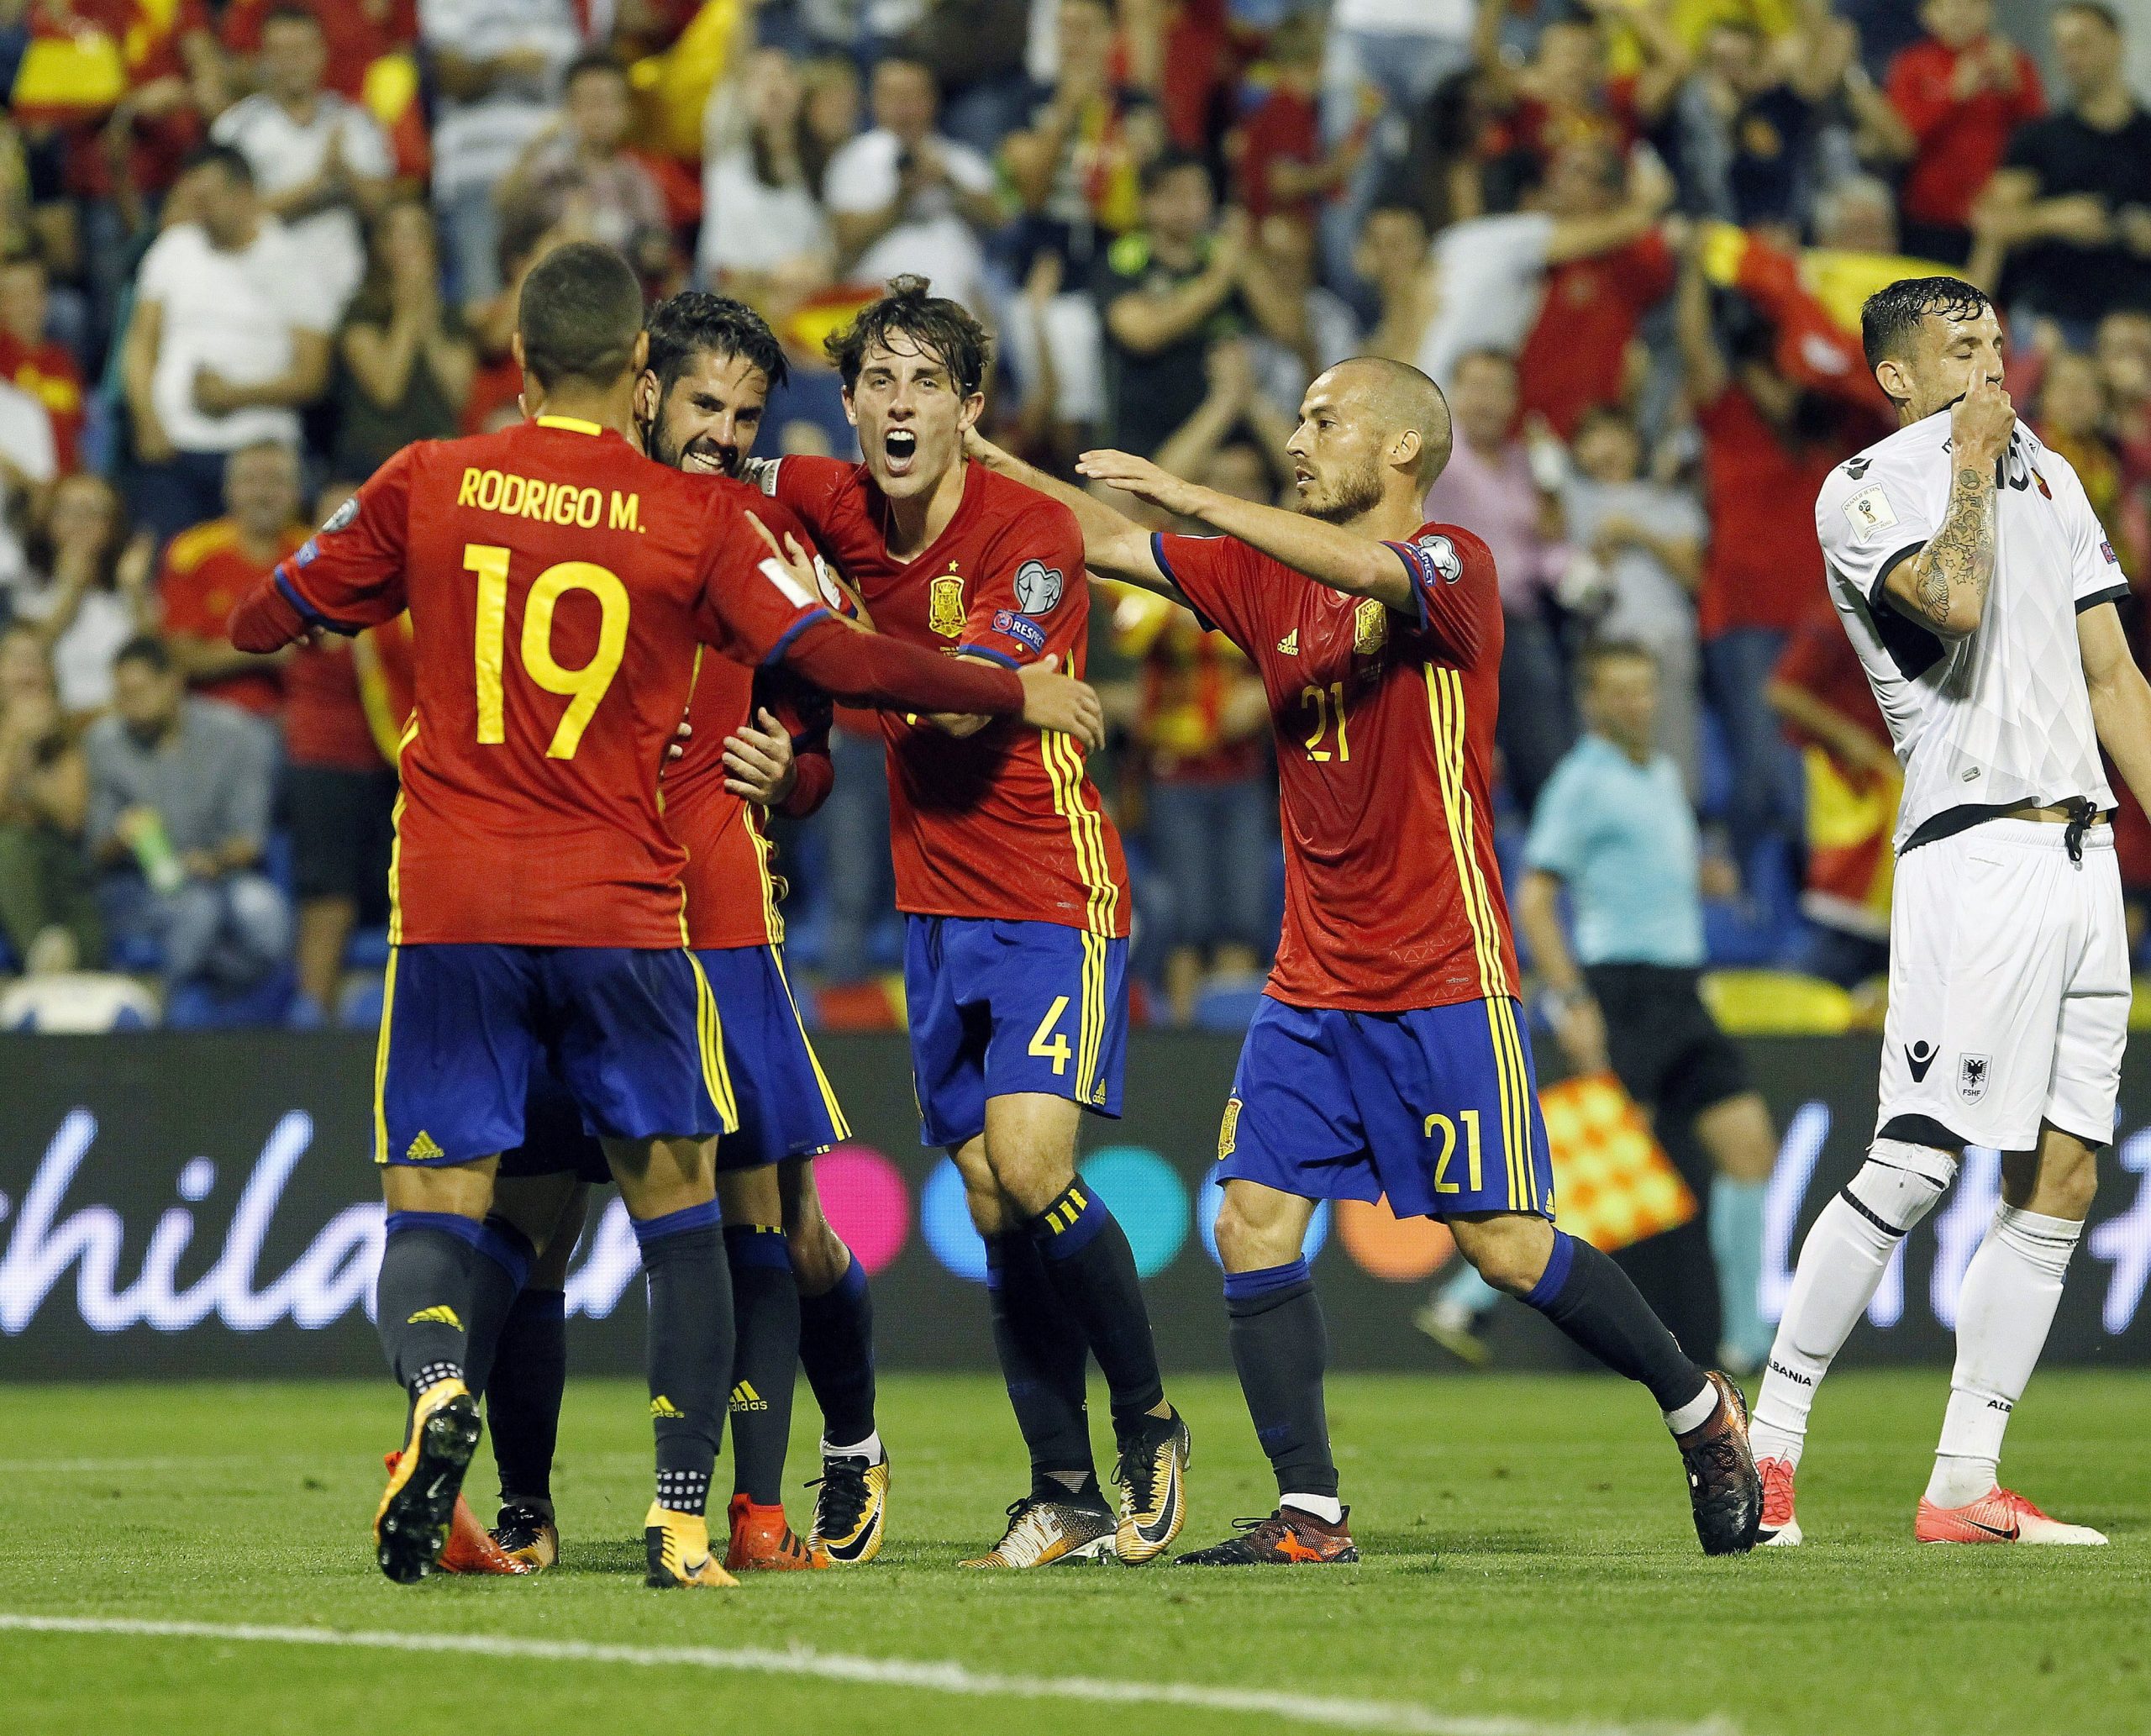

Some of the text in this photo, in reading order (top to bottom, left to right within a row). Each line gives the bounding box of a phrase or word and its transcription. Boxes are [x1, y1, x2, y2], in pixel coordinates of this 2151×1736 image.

[456, 466, 646, 534] RODRIGO M.
[463, 543, 631, 760] 19
[1012, 620, 1045, 649] RESPEC
[1277, 642, 1299, 656] adidas
[1301, 681, 1350, 762] 21
[1028, 995, 1072, 1076] 4
[1962, 1088, 1981, 1097] FSHF
[1424, 1109, 1482, 1194] 21
[1768, 1358, 1812, 1386] LBANIA
[1987, 1399, 2012, 1412] ALB
